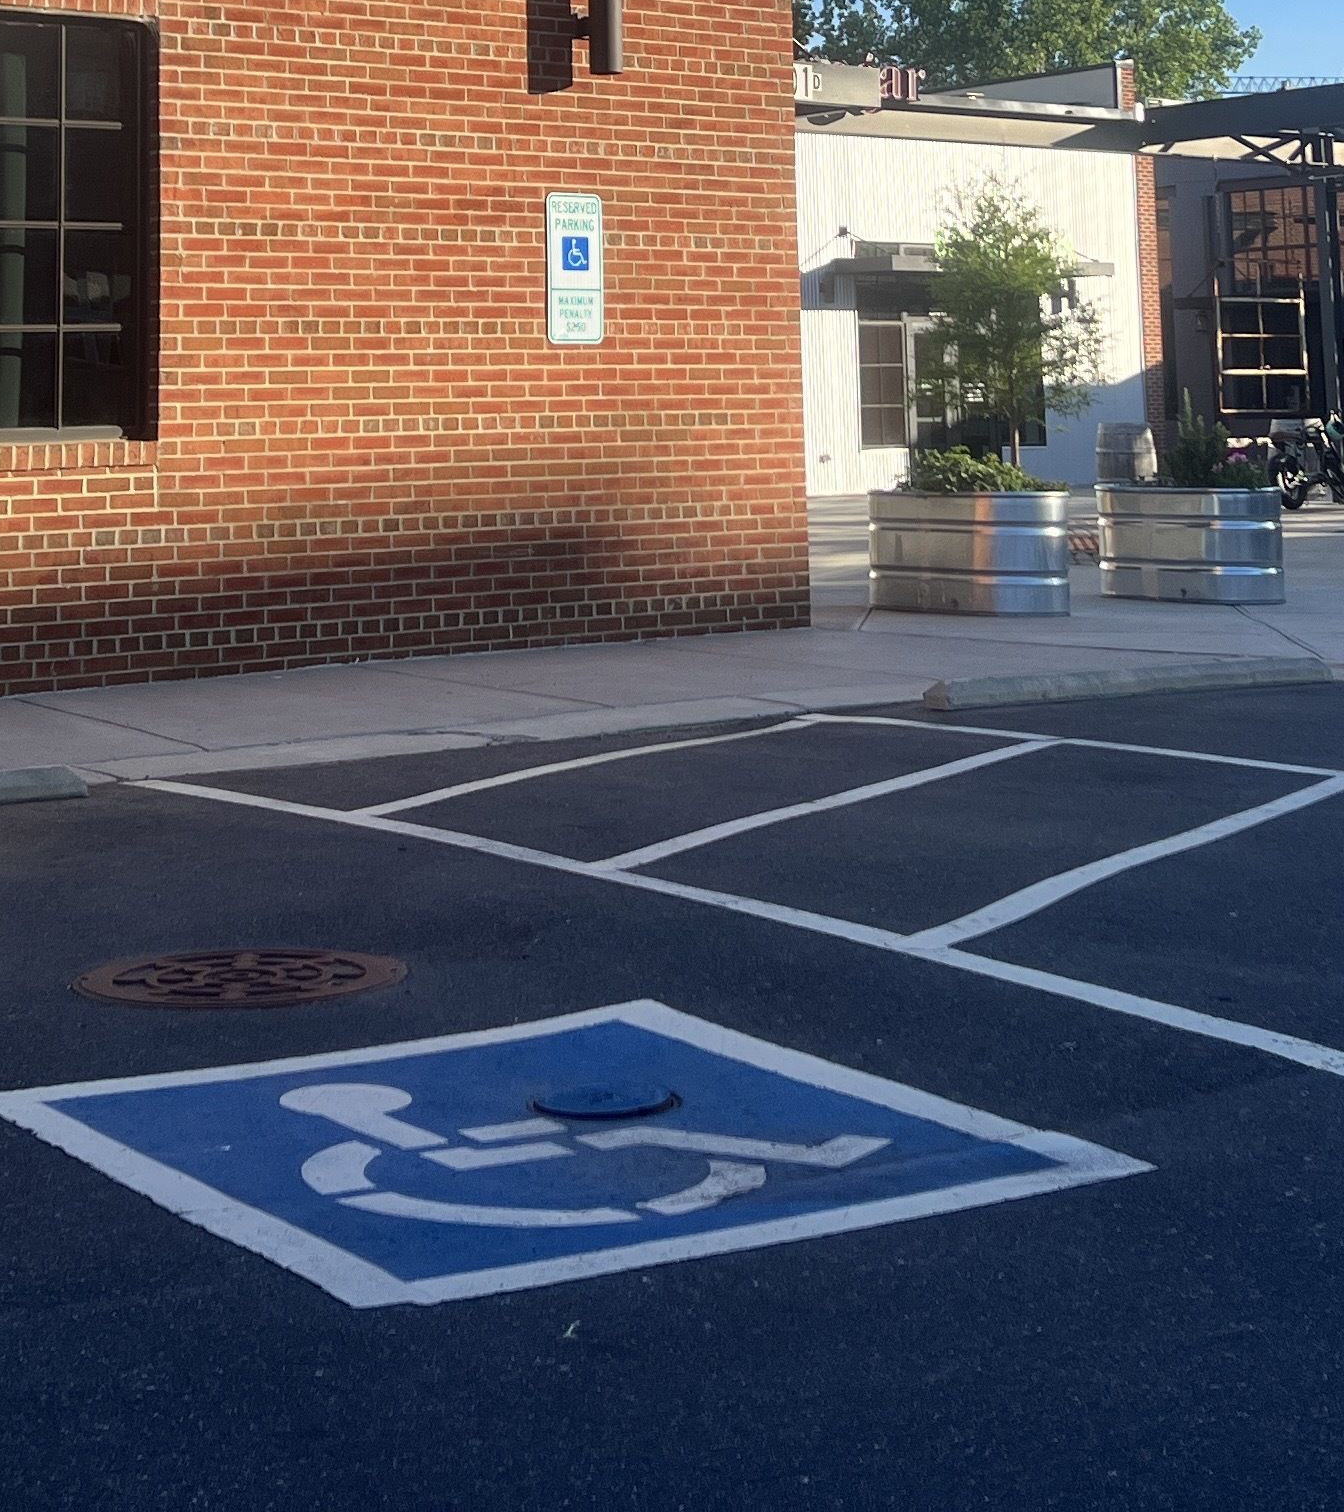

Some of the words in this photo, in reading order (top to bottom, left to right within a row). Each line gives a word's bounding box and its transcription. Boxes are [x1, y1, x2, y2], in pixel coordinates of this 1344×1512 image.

[551, 200, 597, 214] RESERVED
[555, 218, 595, 232] PARKING
[558, 295, 593, 306] MAXIMUM
[559, 308, 592, 319] PENALTY
